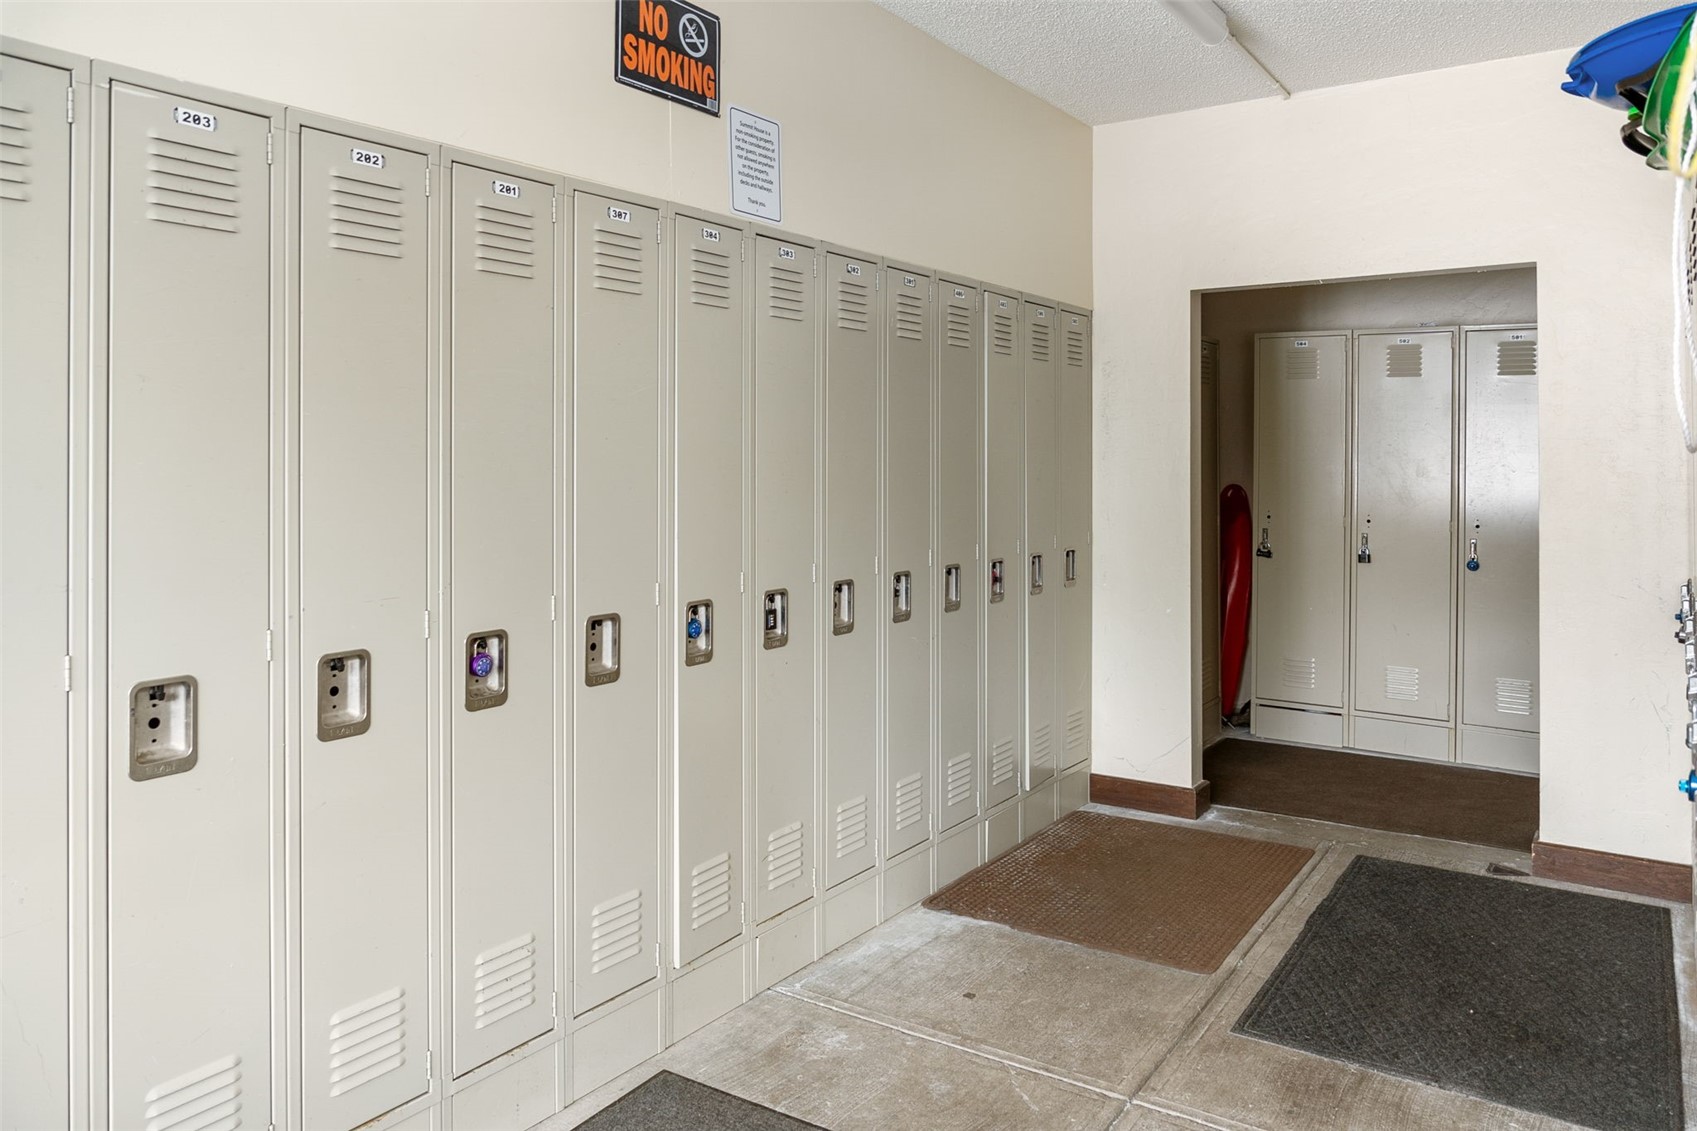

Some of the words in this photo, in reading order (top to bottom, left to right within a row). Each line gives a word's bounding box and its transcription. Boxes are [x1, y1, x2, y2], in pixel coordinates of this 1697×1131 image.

[639, 0, 668, 41] NO
[623, 33, 715, 99] SMOKING
[182, 110, 211, 127] 203
[740, 120, 753, 129] Summit
[754, 126, 764, 134] House
[748, 140, 771, 151] consideration
[356, 151, 380, 166] 202
[744, 155, 758, 164] allowed
[499, 183, 517, 196] 201
[748, 196, 758, 204] Thank
[612, 209, 628, 221] 307
[704, 229, 718, 240] 304
[782, 248, 794, 258] 303
